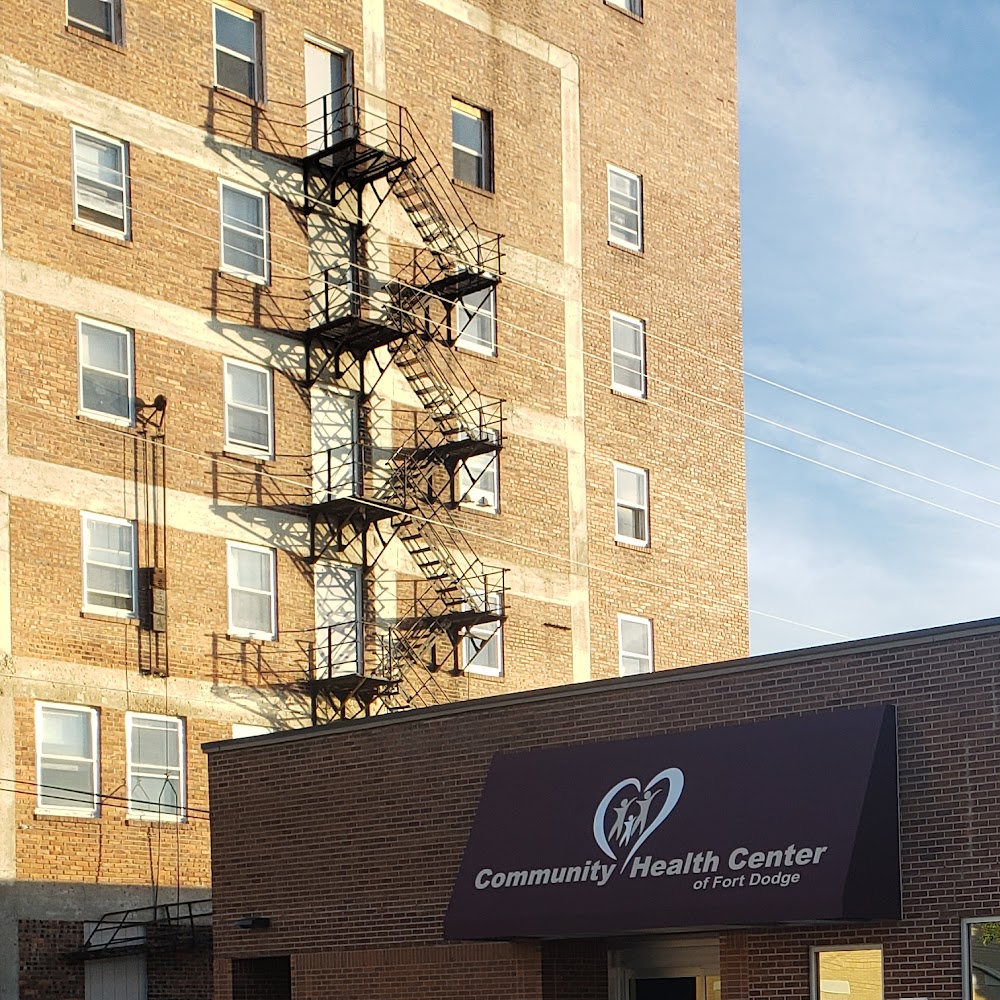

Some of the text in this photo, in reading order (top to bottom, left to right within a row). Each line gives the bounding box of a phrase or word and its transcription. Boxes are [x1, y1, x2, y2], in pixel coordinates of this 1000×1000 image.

[474, 844, 828, 890] Community Health Center
[693, 871, 801, 890] of Fort Dodge
